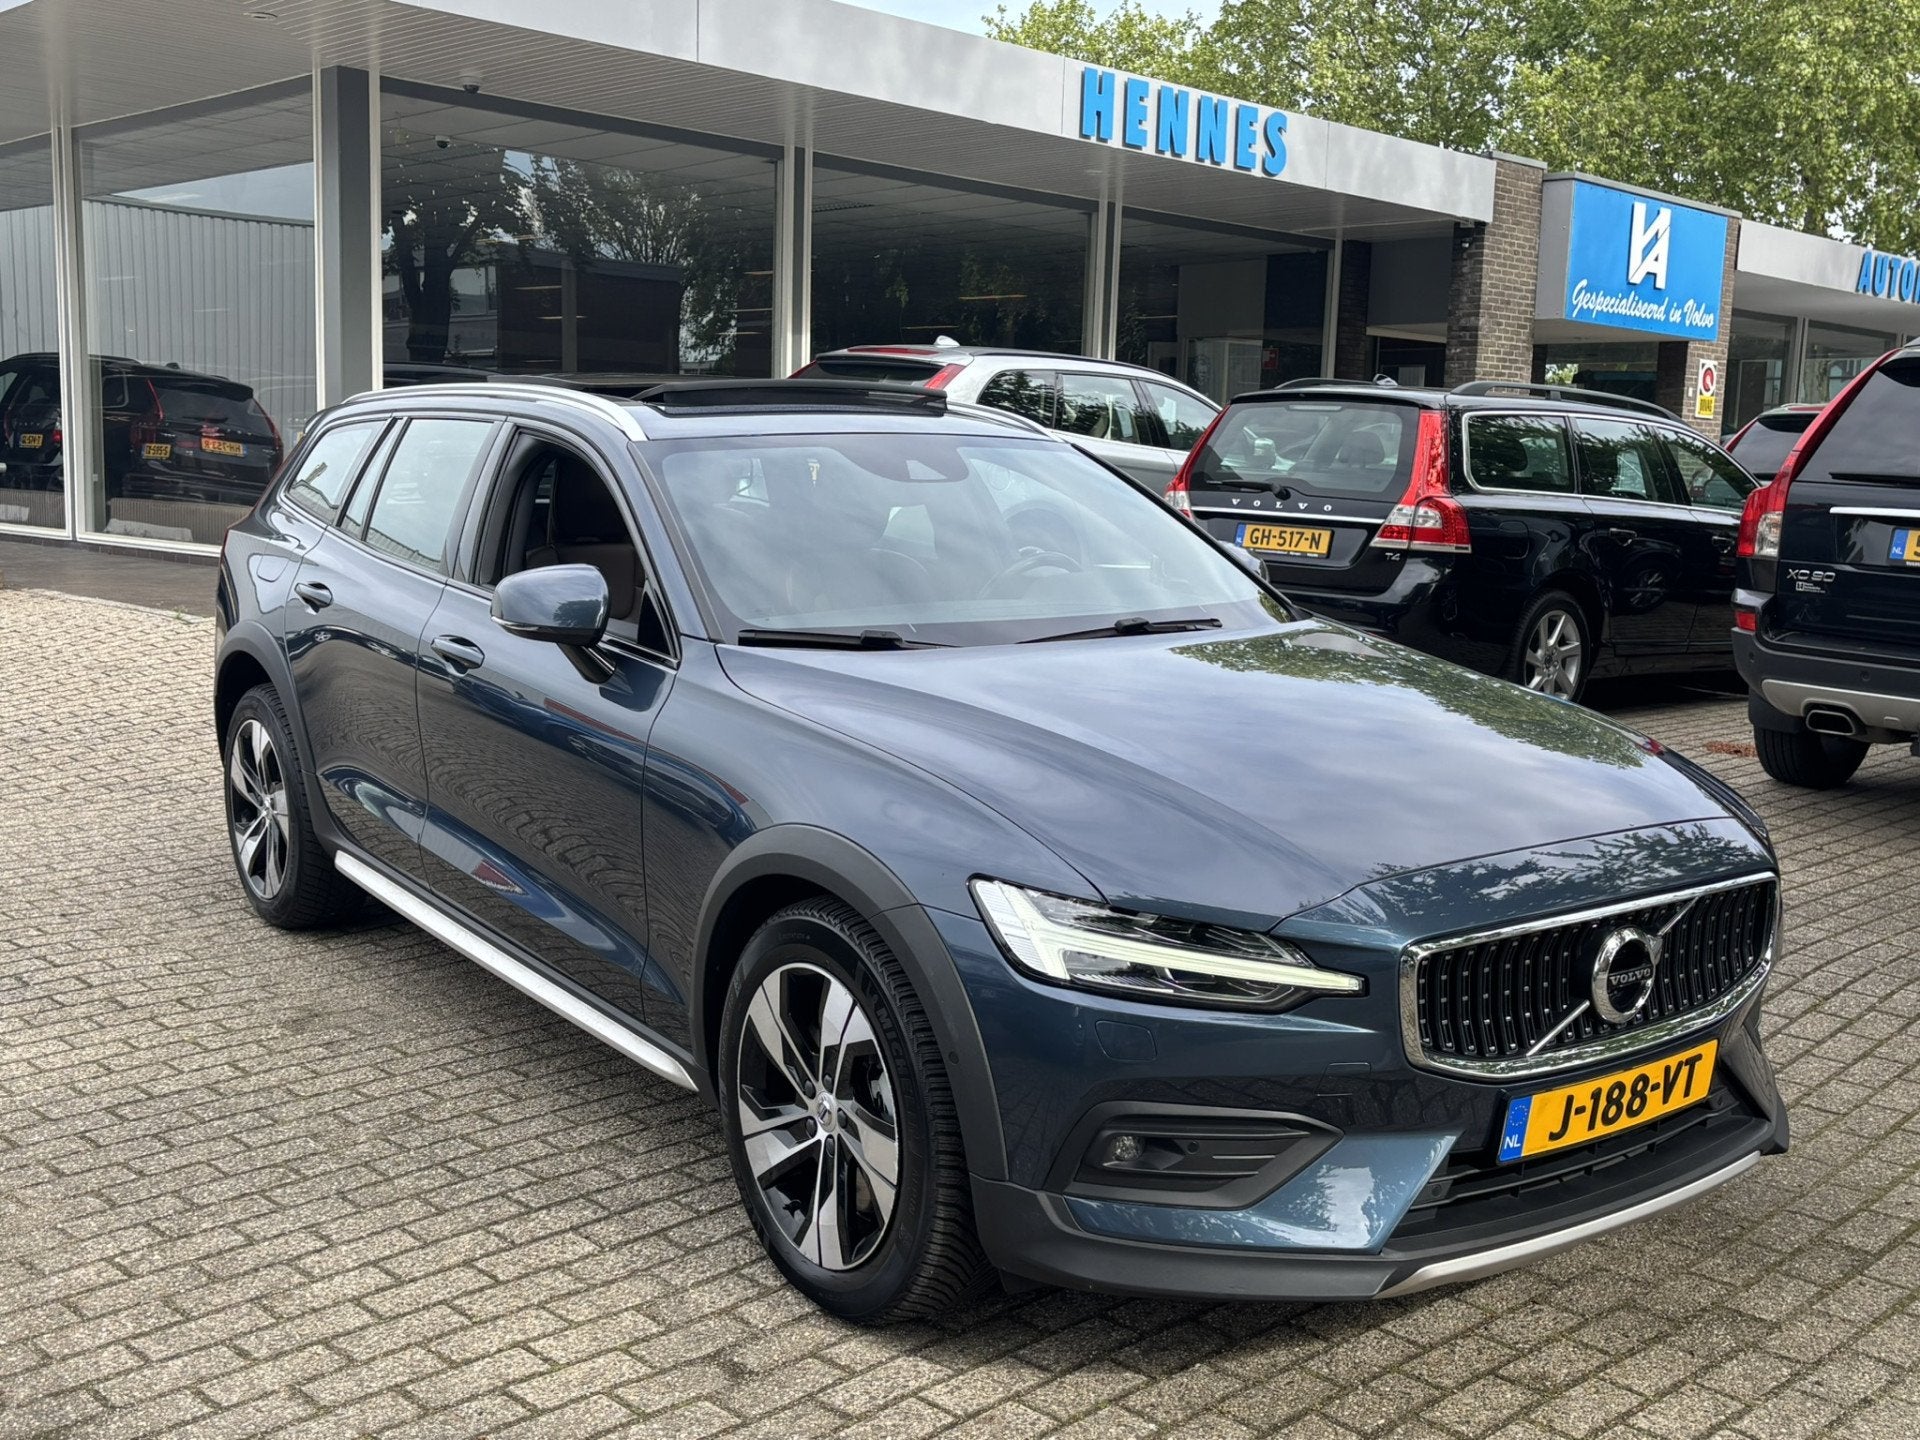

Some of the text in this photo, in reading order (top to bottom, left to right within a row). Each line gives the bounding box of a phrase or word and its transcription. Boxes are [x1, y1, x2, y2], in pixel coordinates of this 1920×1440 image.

[1080, 67, 1288, 176] HENNES
[1572, 279, 1714, 328] Gespecialiseerd in Volvo
[1232, 498, 1333, 512] VOLVO
[1250, 527, 1321, 550] GH-517-N
[1385, 552, 1400, 561] T4
[1892, 547, 1903, 555] NL
[1609, 968, 1651, 986] VOLVO
[1548, 1053, 1703, 1142] J-188-VT
[1504, 1134, 1521, 1149] NL
